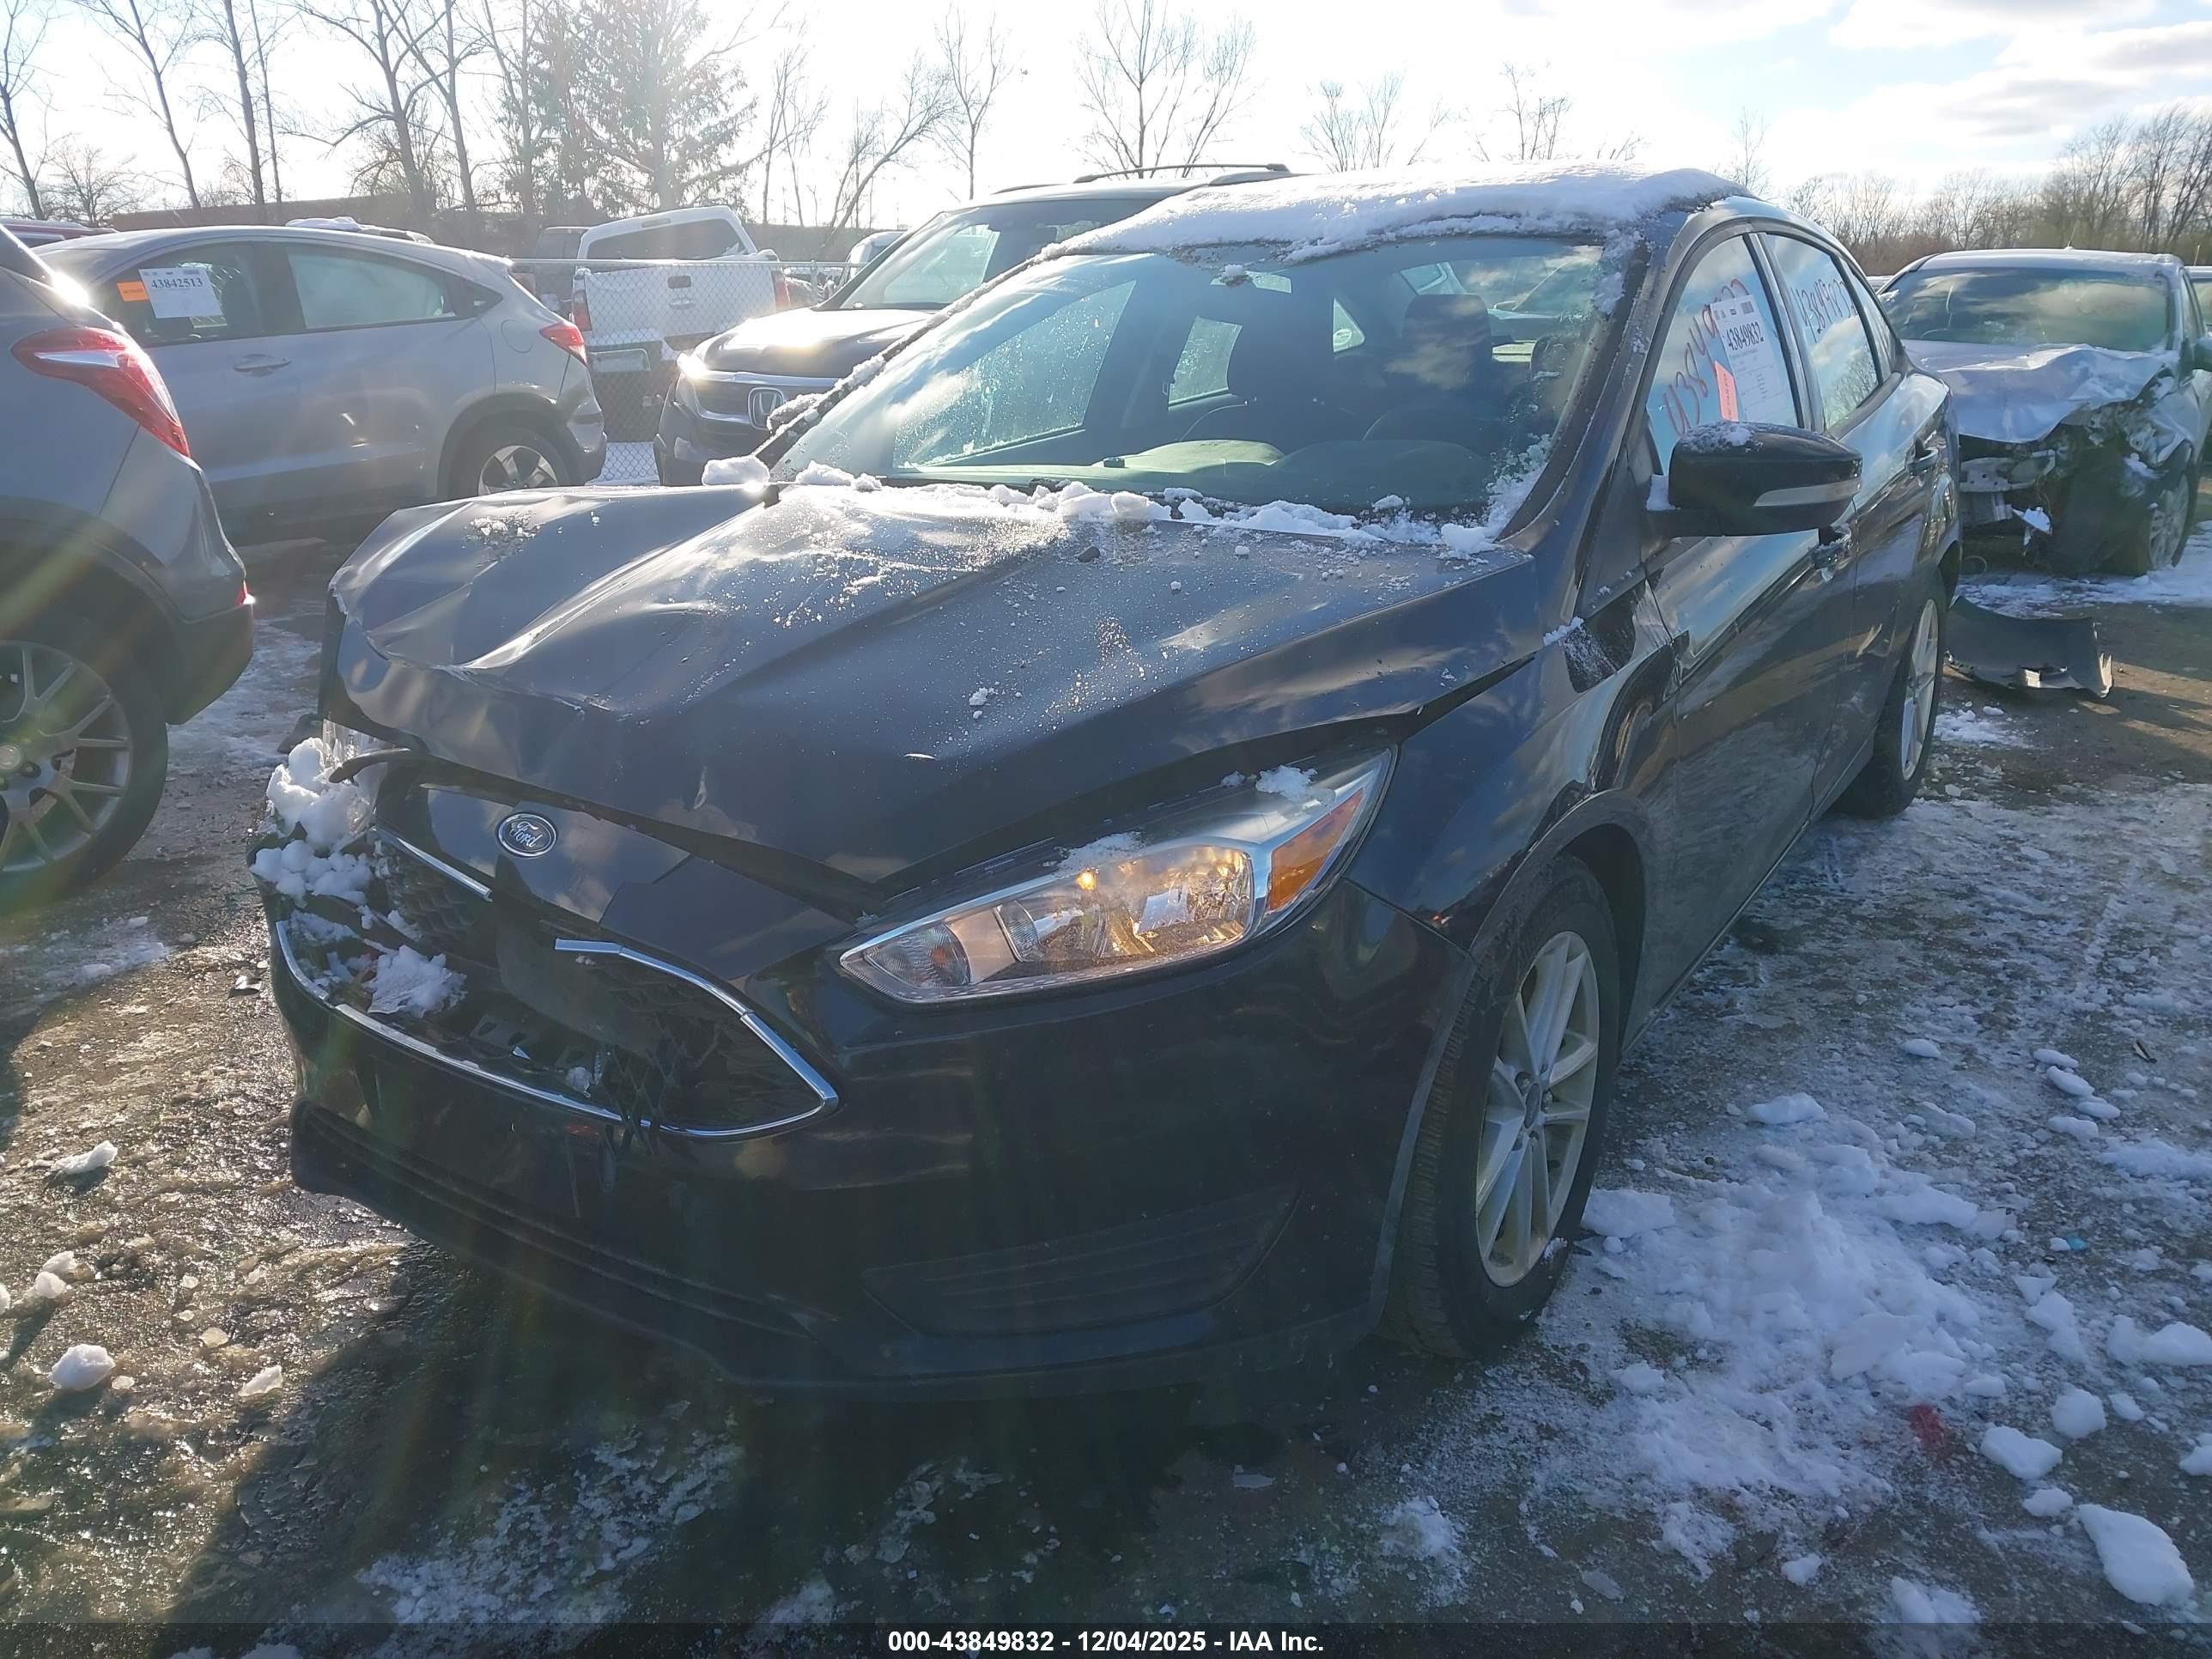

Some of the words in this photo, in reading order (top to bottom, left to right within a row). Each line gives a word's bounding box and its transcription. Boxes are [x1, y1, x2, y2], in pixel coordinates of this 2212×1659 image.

[151, 277, 203, 289] 43842513
[1727, 321, 1765, 351] 43849832
[509, 821, 543, 848] Ford
